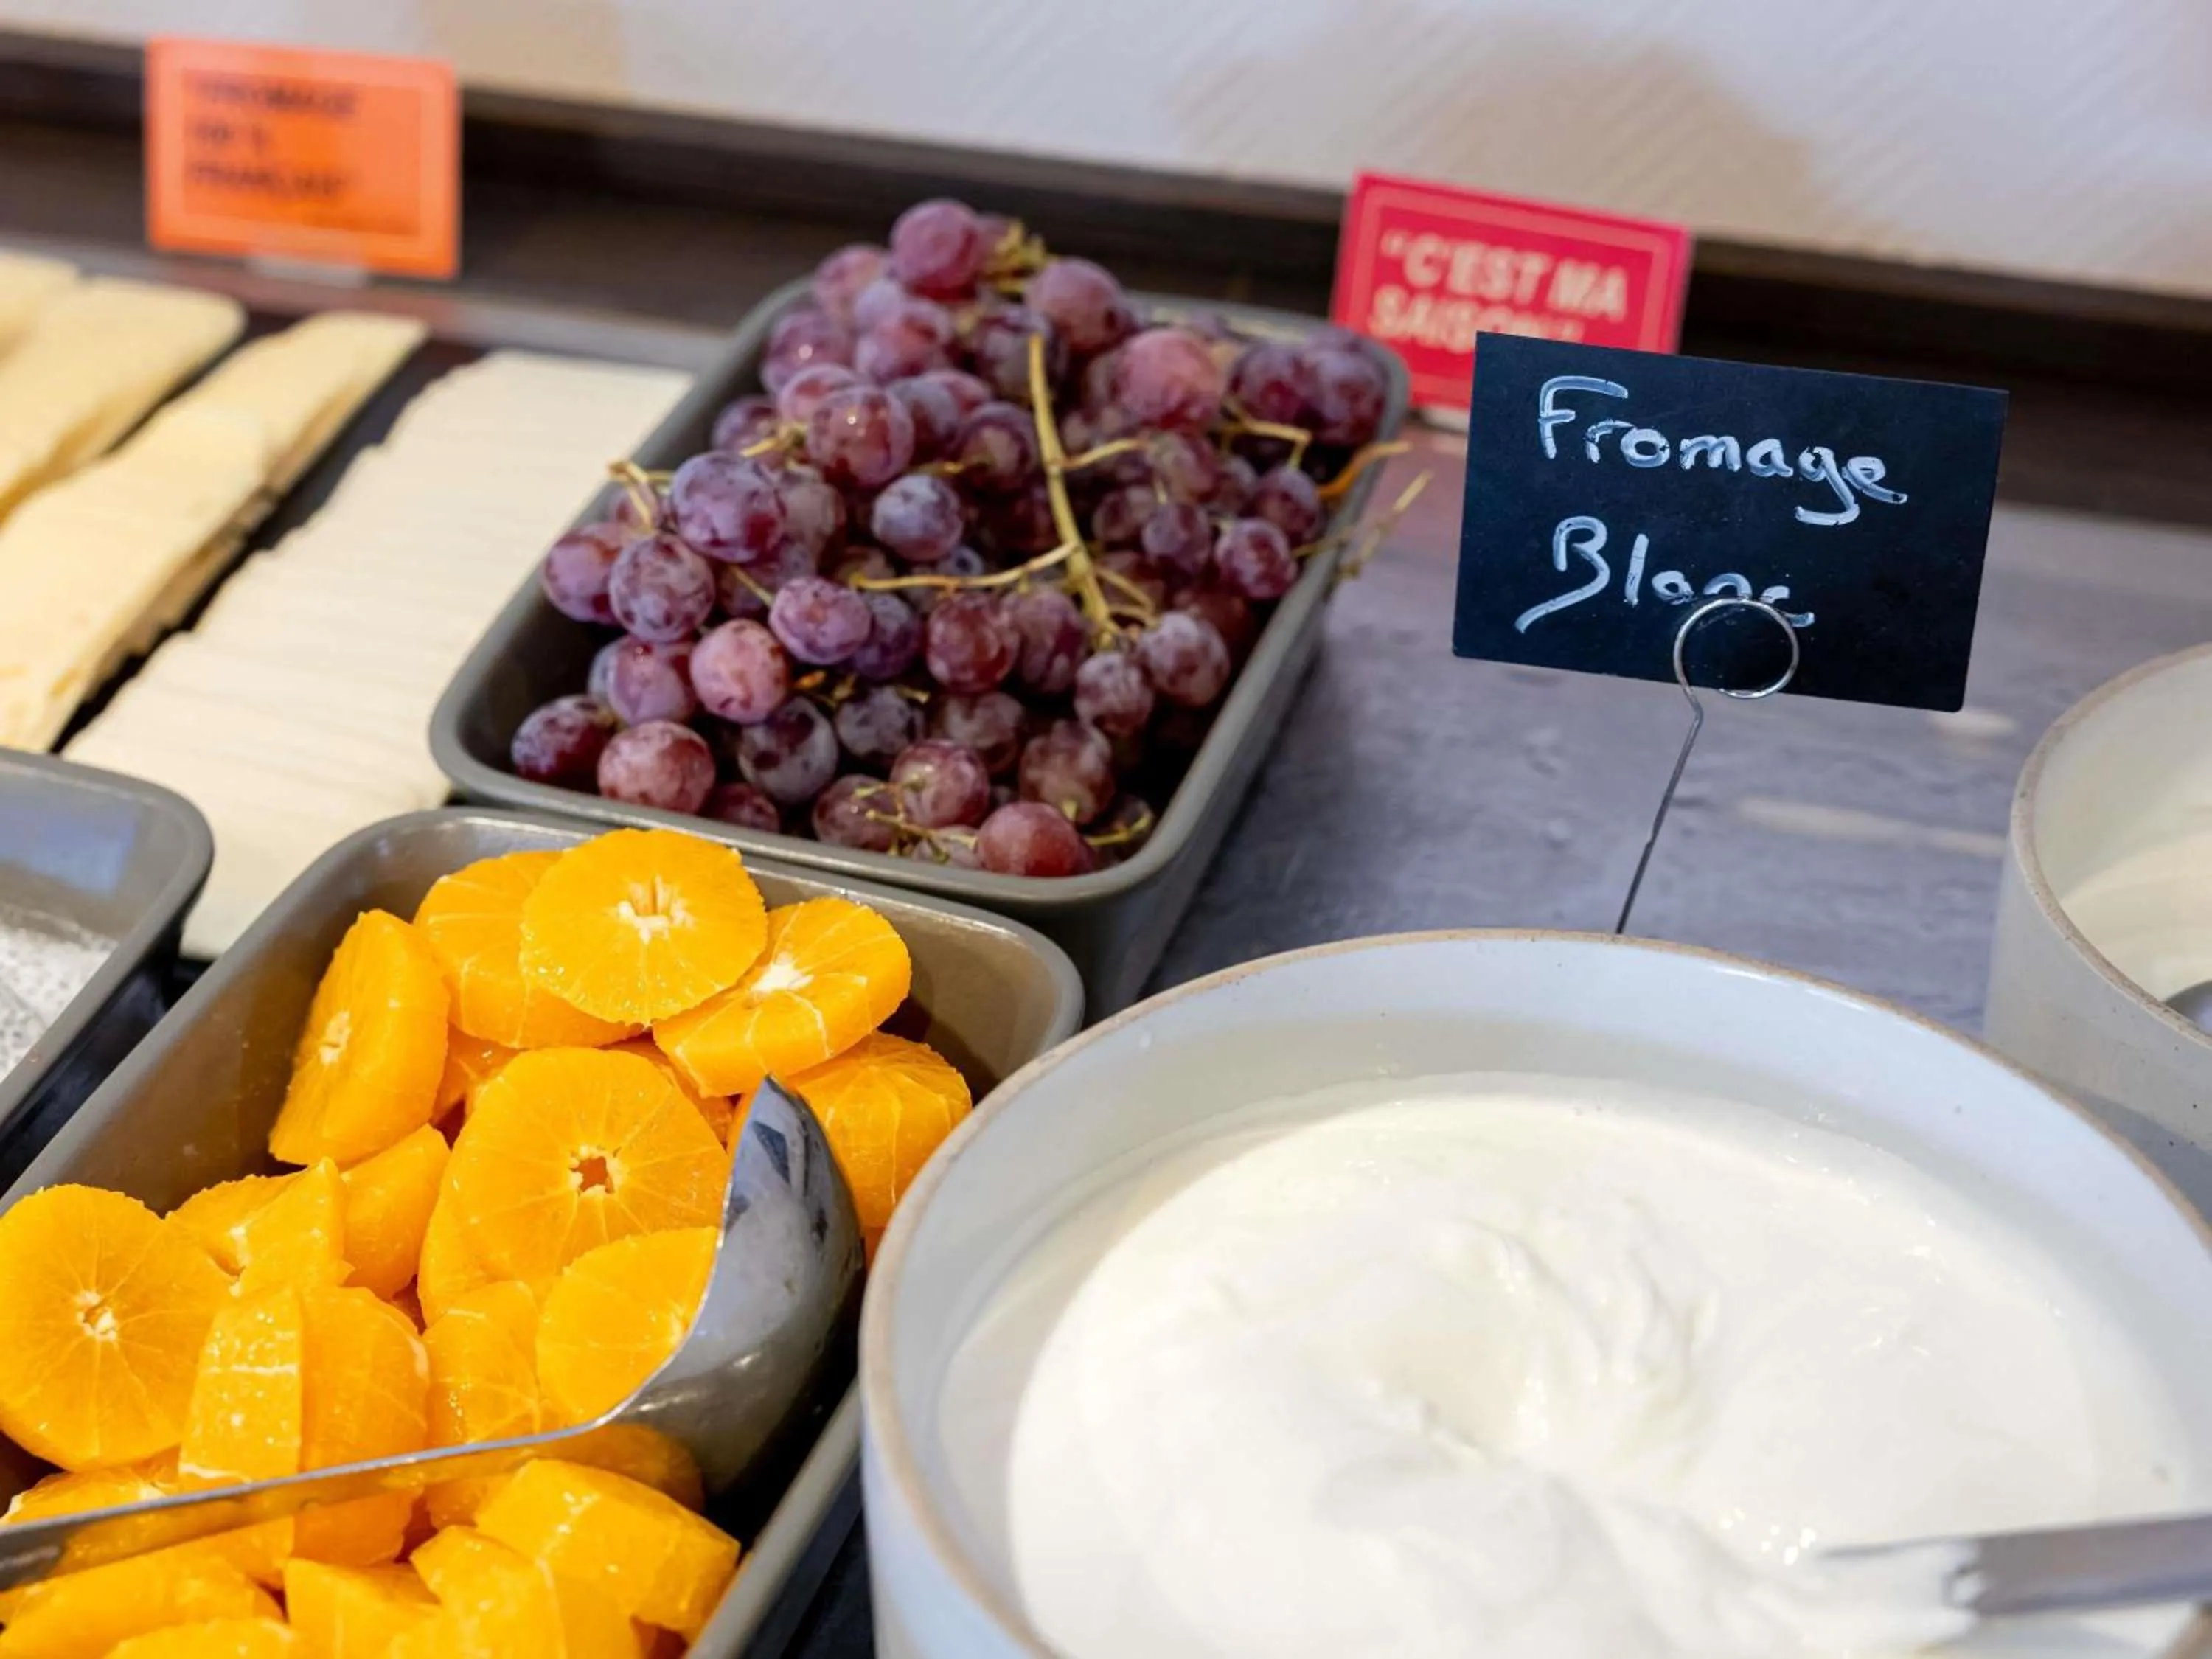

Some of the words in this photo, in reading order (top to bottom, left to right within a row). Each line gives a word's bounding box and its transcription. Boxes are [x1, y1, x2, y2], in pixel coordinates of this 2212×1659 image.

[1548, 260, 1627, 320] MA
[1538, 375, 1908, 526] Fromage
[1514, 515, 1815, 634] Blanc
